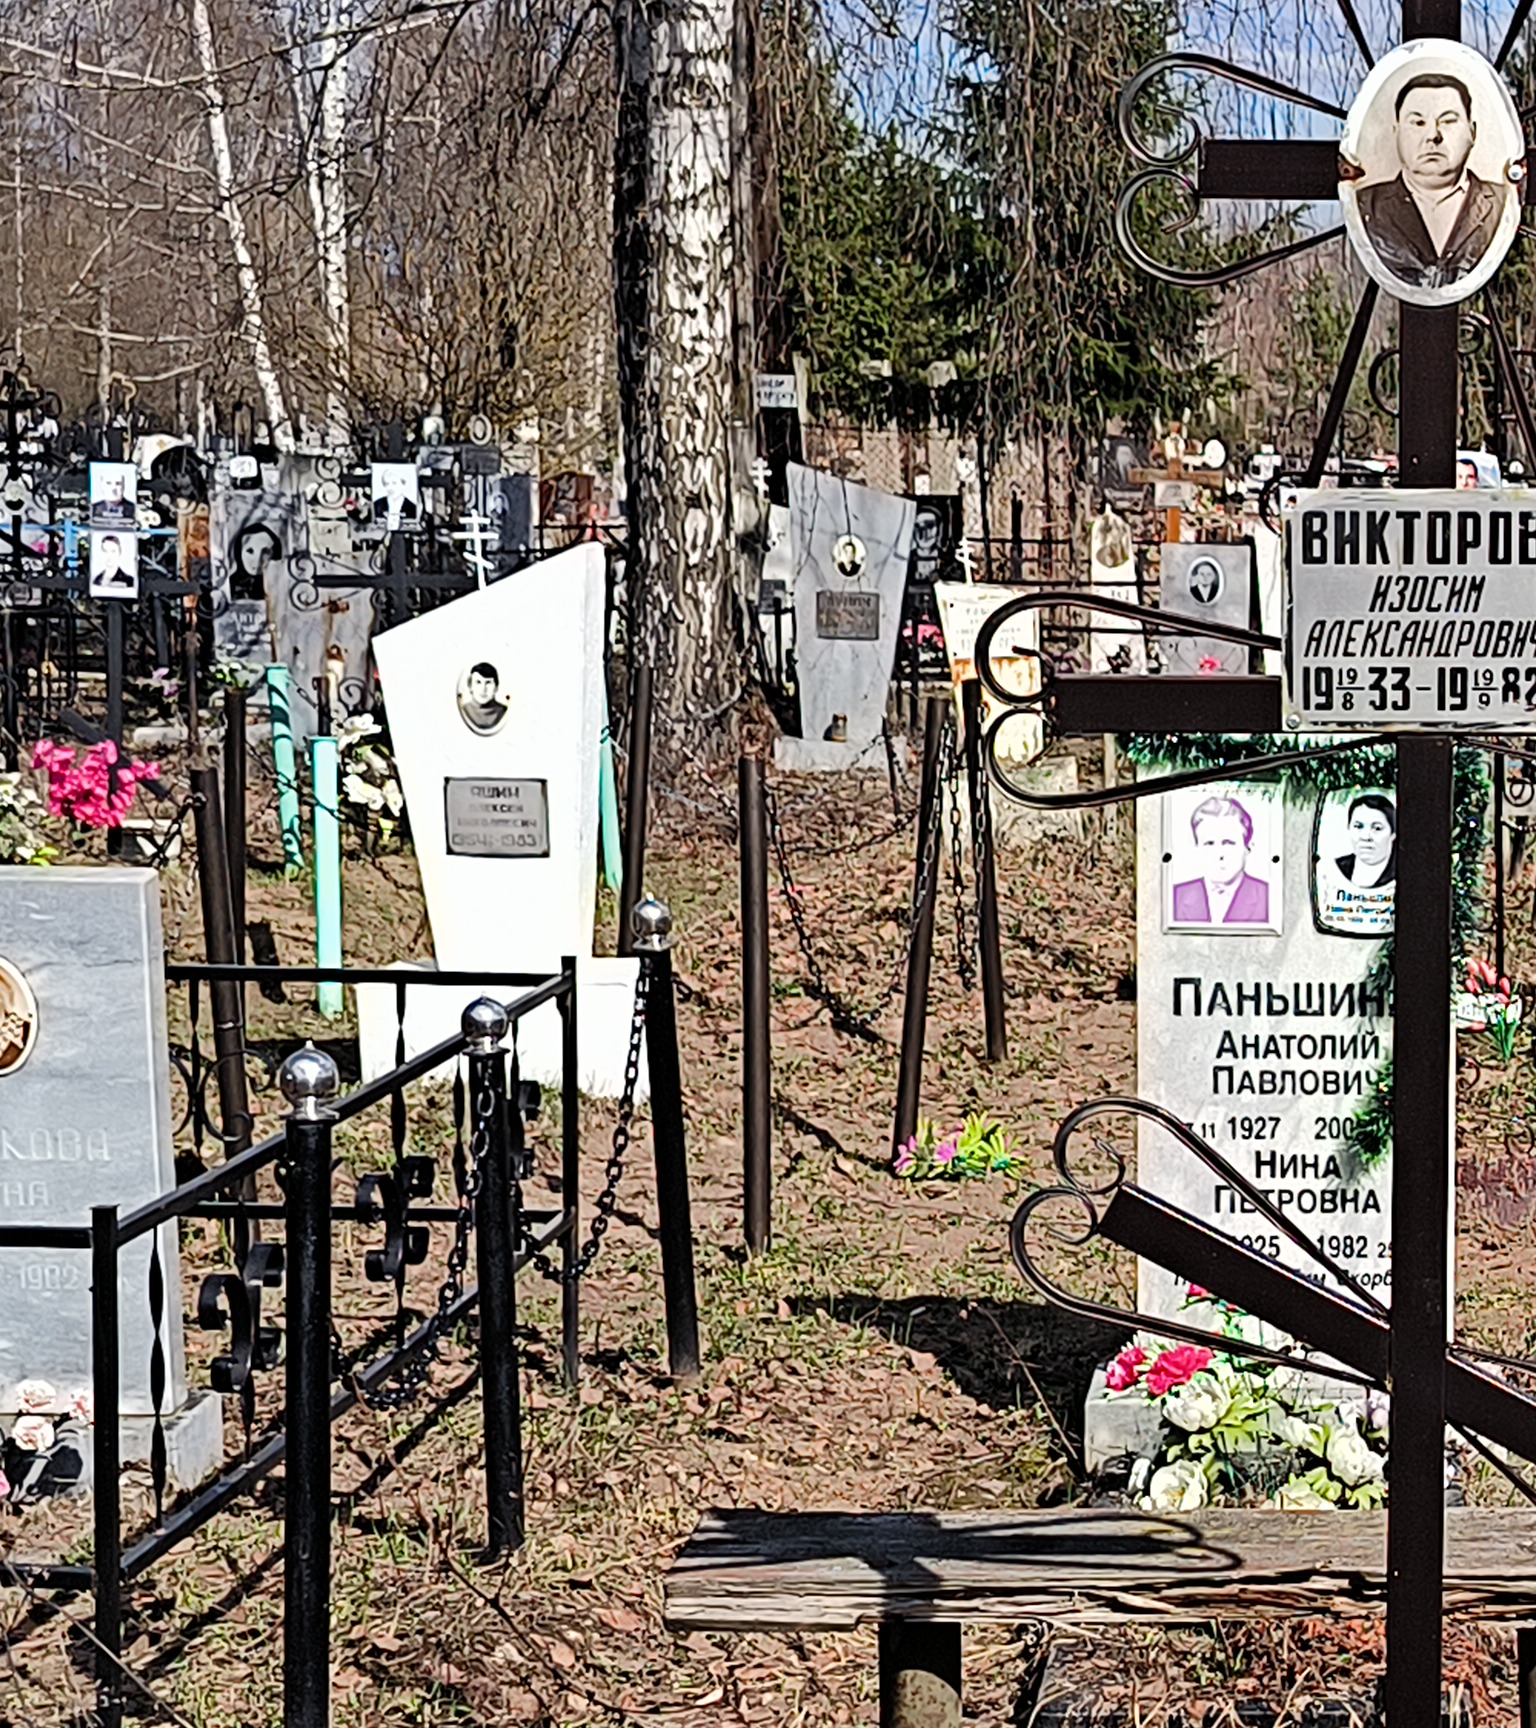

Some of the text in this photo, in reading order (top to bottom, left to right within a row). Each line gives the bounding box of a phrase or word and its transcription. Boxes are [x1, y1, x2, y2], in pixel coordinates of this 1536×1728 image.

[1368, 575, 1487, 613] ИЗОСИМ
[1172, 977, 1394, 1018] ПАНЬШИН
[1215, 1030, 1380, 1060] АНАТОЛИЙ
[1227, 1116, 1282, 1141] 1927
[1314, 1116, 1358, 1141] 200
[1254, 1150, 1343, 1180] НИНА
[1234, 1235, 1281, 1259] 925
[1317, 1235, 1368, 1259] 1982
